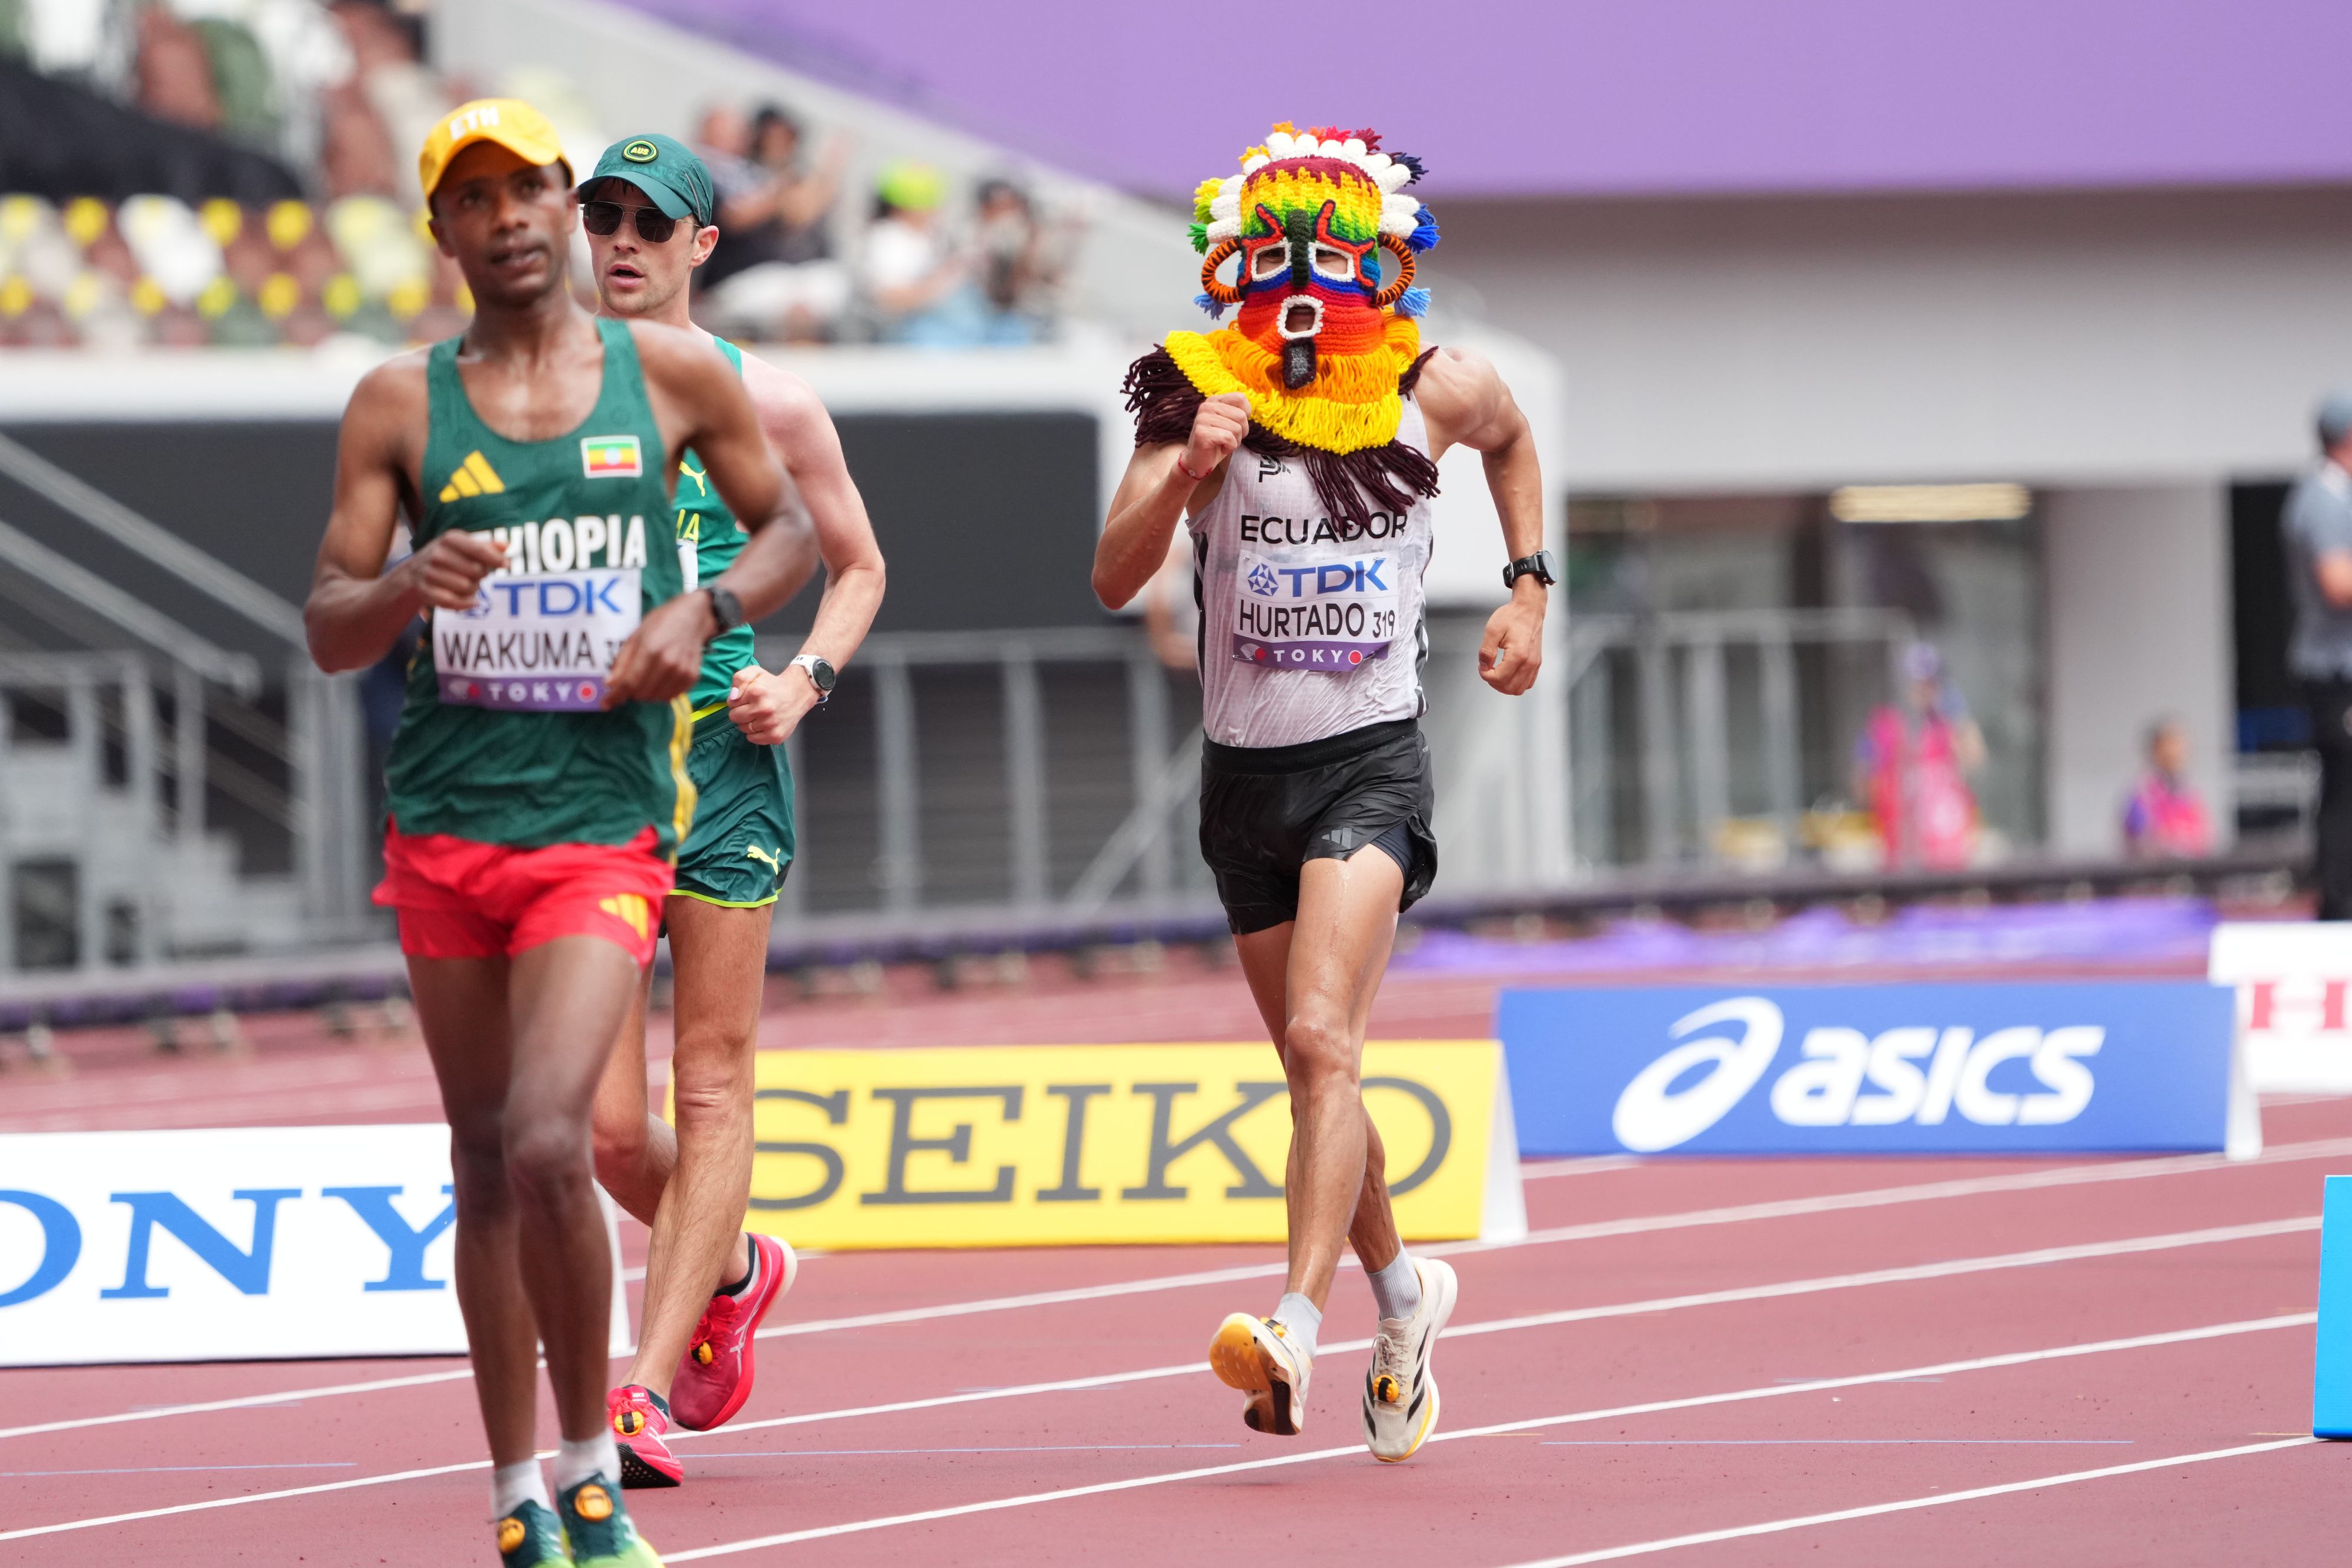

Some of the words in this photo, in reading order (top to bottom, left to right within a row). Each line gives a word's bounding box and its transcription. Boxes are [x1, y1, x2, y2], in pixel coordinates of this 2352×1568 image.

[449, 106, 499, 141] ETH
[630, 146, 649, 155] AUS
[1241, 511, 1408, 545] ECUADOR
[493, 577, 623, 616] TDK
[1278, 558, 1388, 597] TDK
[1240, 599, 1365, 637] HURTADO
[1372, 610, 1395, 638] 319
[442, 630, 596, 670] WAKUMA
[749, 1076, 1452, 1211] SEIKO
